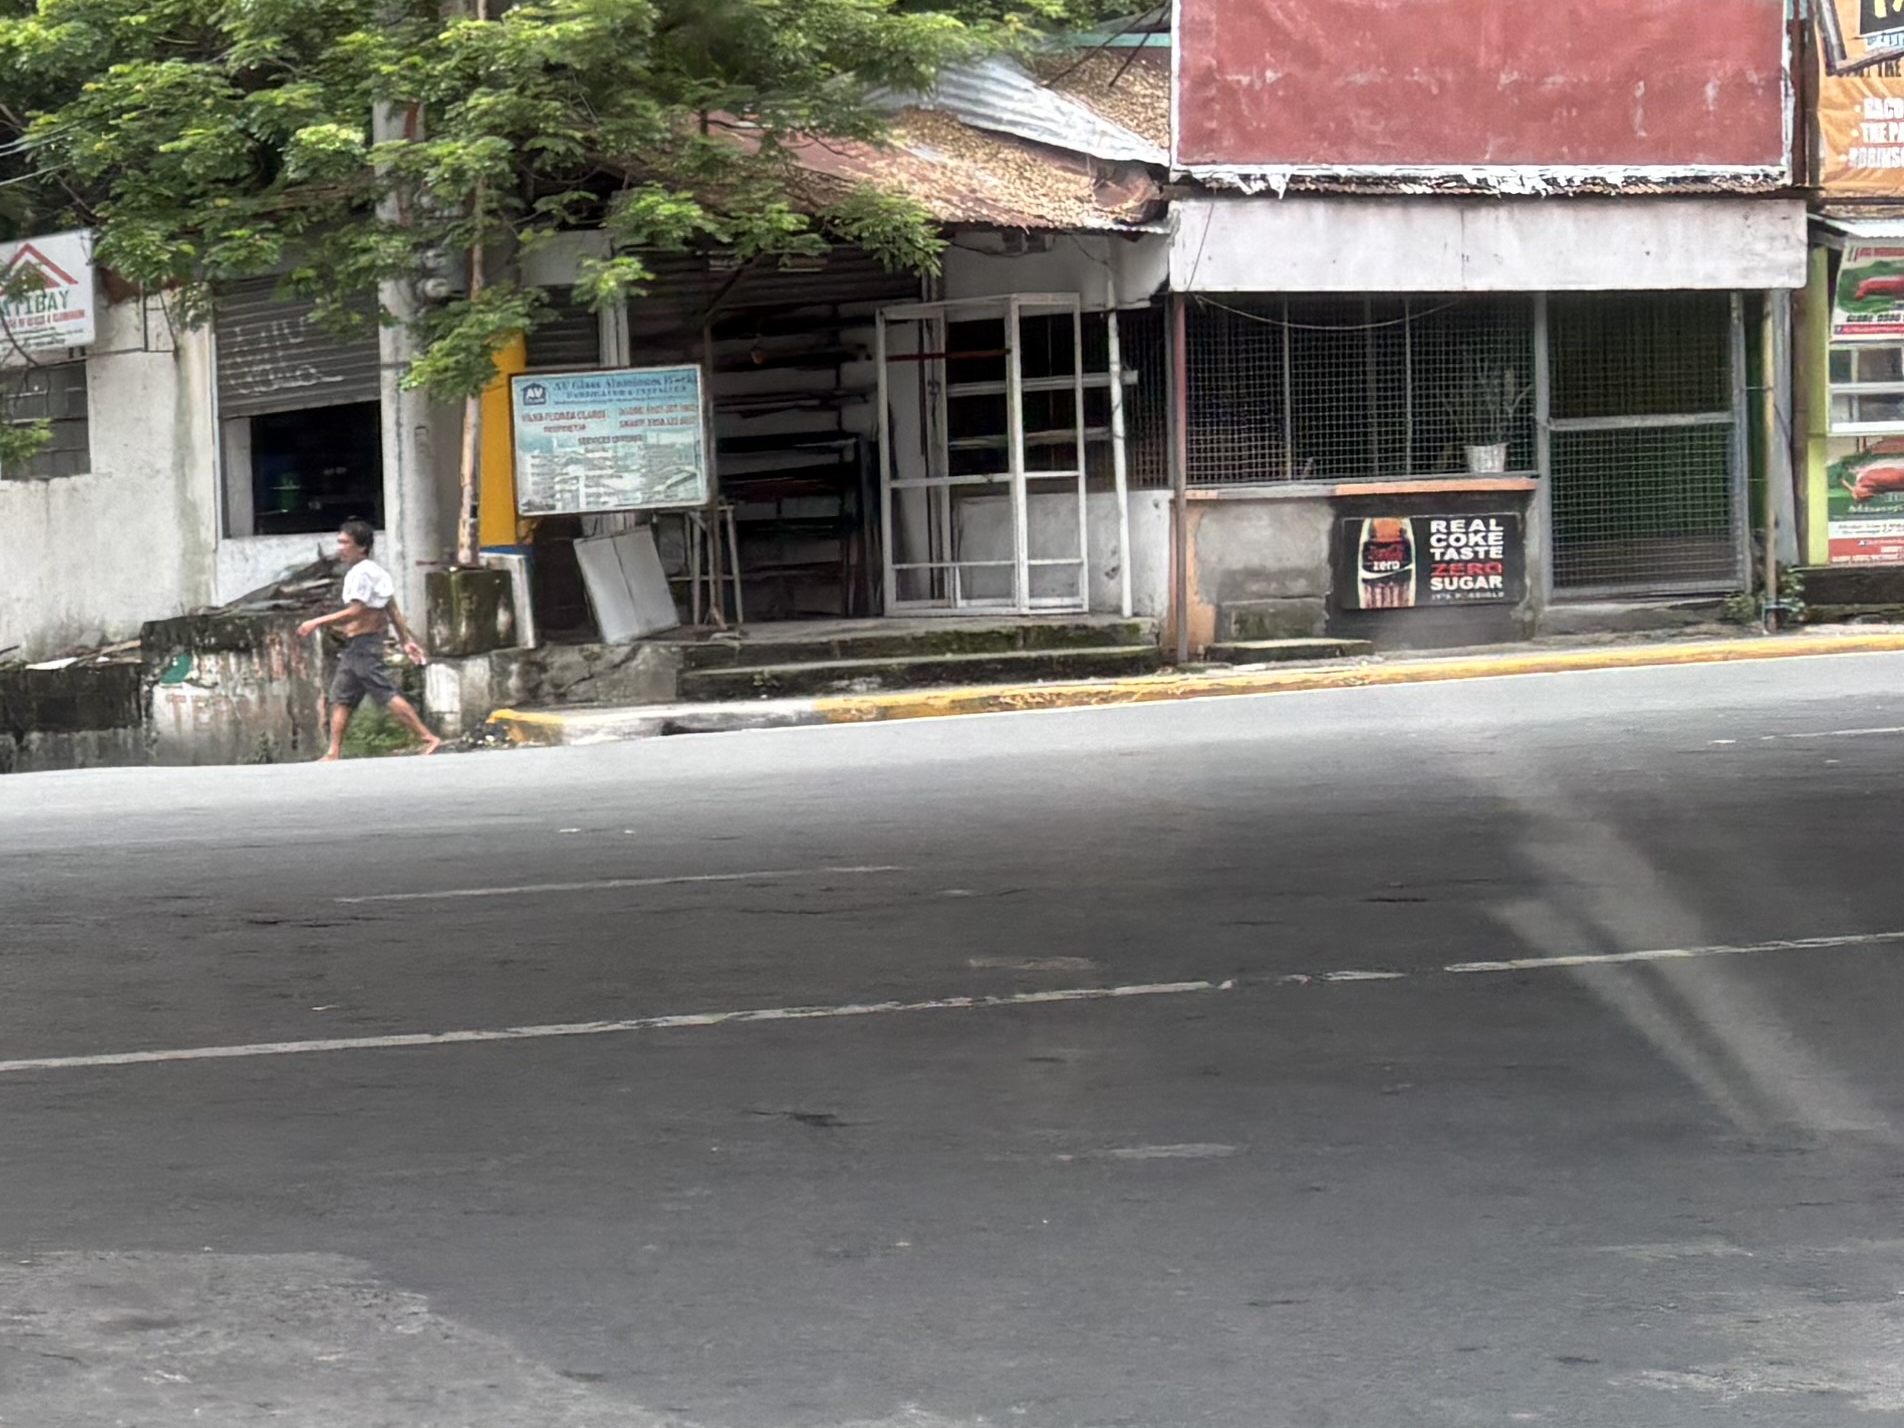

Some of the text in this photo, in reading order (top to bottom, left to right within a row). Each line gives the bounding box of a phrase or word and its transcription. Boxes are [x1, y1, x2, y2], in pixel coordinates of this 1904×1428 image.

[1430, 518, 1505, 533] REAL
[1430, 532, 1505, 548] COKE
[1430, 546, 1505, 560] TASTE
[1431, 561, 1505, 576] ZERO
[1430, 575, 1503, 591] SUGAR
